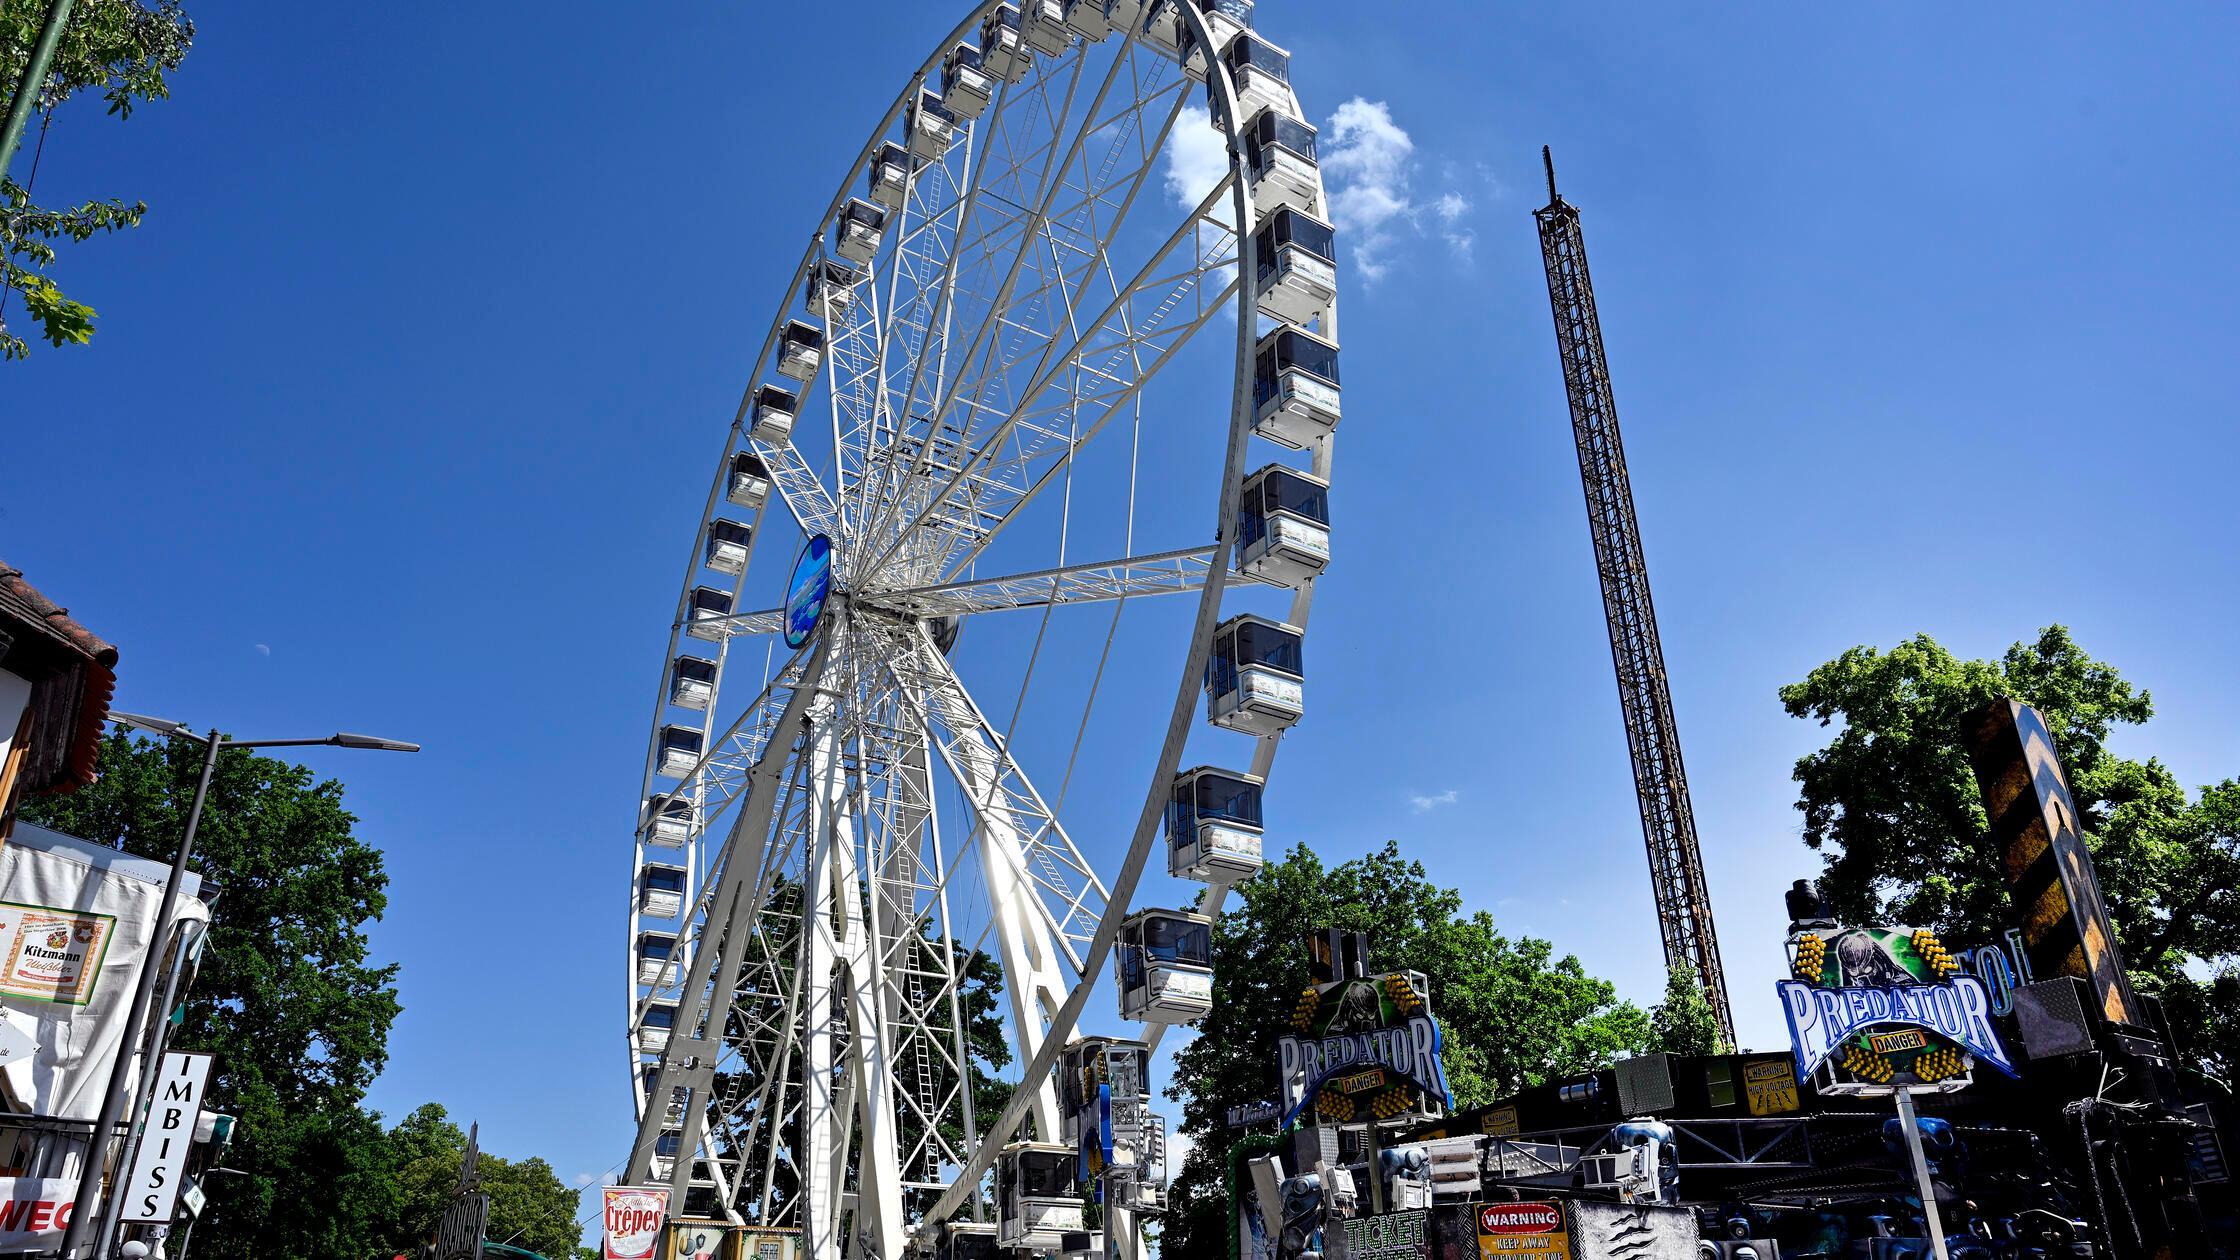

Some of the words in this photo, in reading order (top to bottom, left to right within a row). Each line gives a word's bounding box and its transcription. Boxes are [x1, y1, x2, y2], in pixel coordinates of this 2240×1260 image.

[24, 945, 81, 962] Kitzmann
[25, 958, 73, 973] Weißbier
[1784, 977, 2012, 1073] PREDATOR
[1876, 1031, 1924, 1053] DANGER
[1279, 1015, 1446, 1117] PREDATOR
[1752, 1064, 1784, 1078] WARNING
[1346, 1071, 1383, 1093] DANGER
[1748, 1084, 1763, 1095] HIGH
[1765, 1079, 1795, 1093] VOLTAGE
[141, 1055, 193, 1217] IMBISS
[605, 1205, 661, 1235] Crêpes
[1485, 1211, 1557, 1226] WARNING
[1343, 1210, 1427, 1252] TICKET
[1496, 1238, 1520, 1250] KEEP
[1522, 1237, 1550, 1249] AWAY
